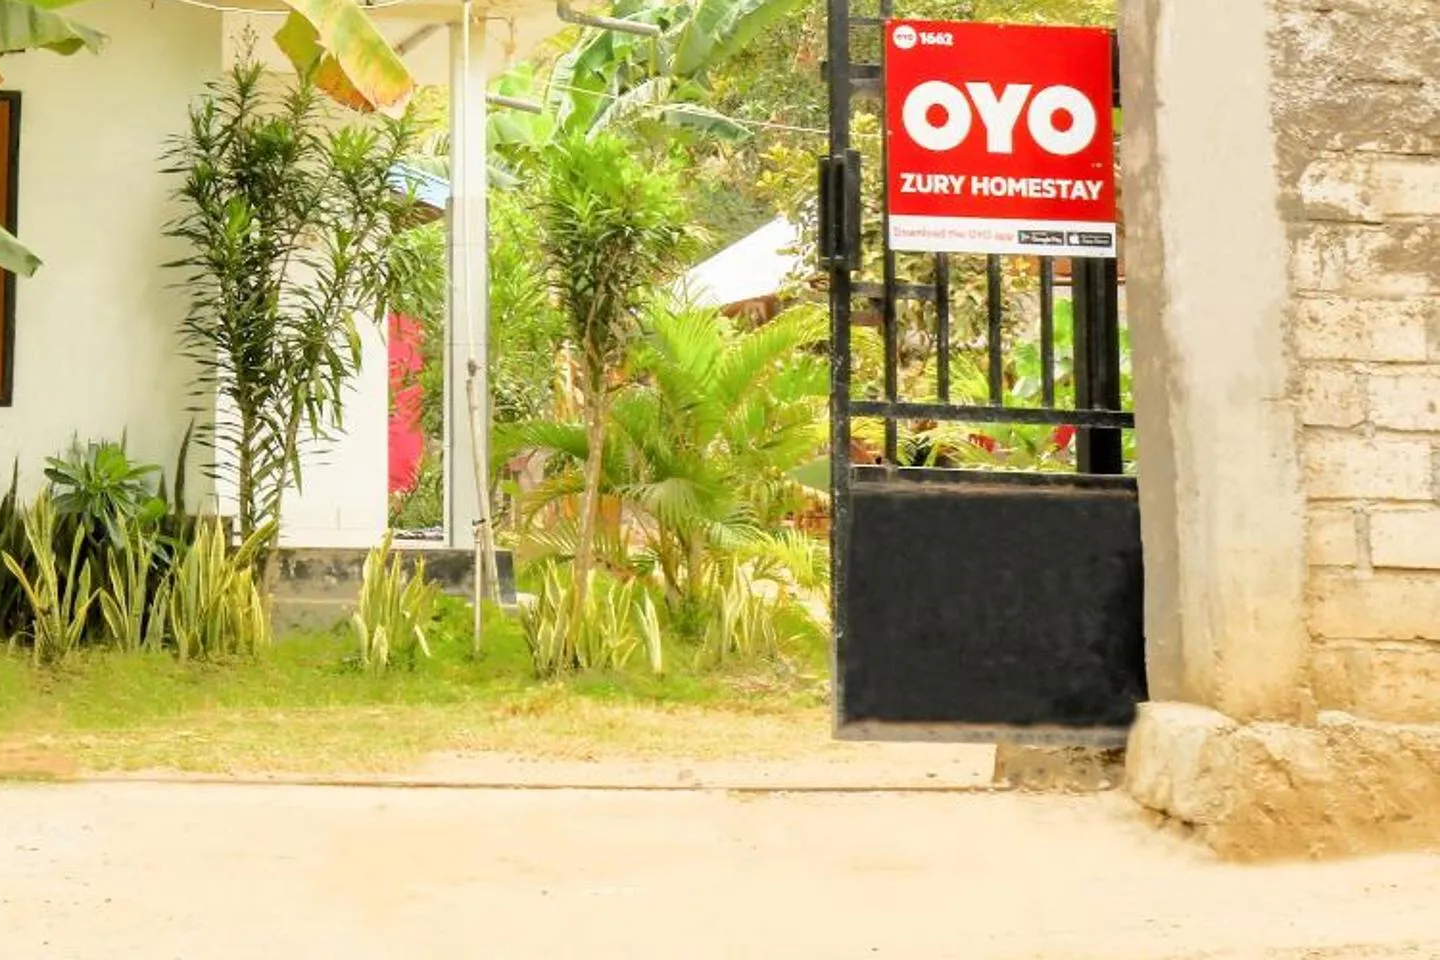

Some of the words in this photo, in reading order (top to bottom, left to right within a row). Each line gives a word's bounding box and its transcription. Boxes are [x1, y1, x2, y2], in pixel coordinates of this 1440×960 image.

[902, 80, 1097, 156] OYO
[900, 173, 965, 195] ZURY
[971, 176, 1103, 200] HOMESTAY
